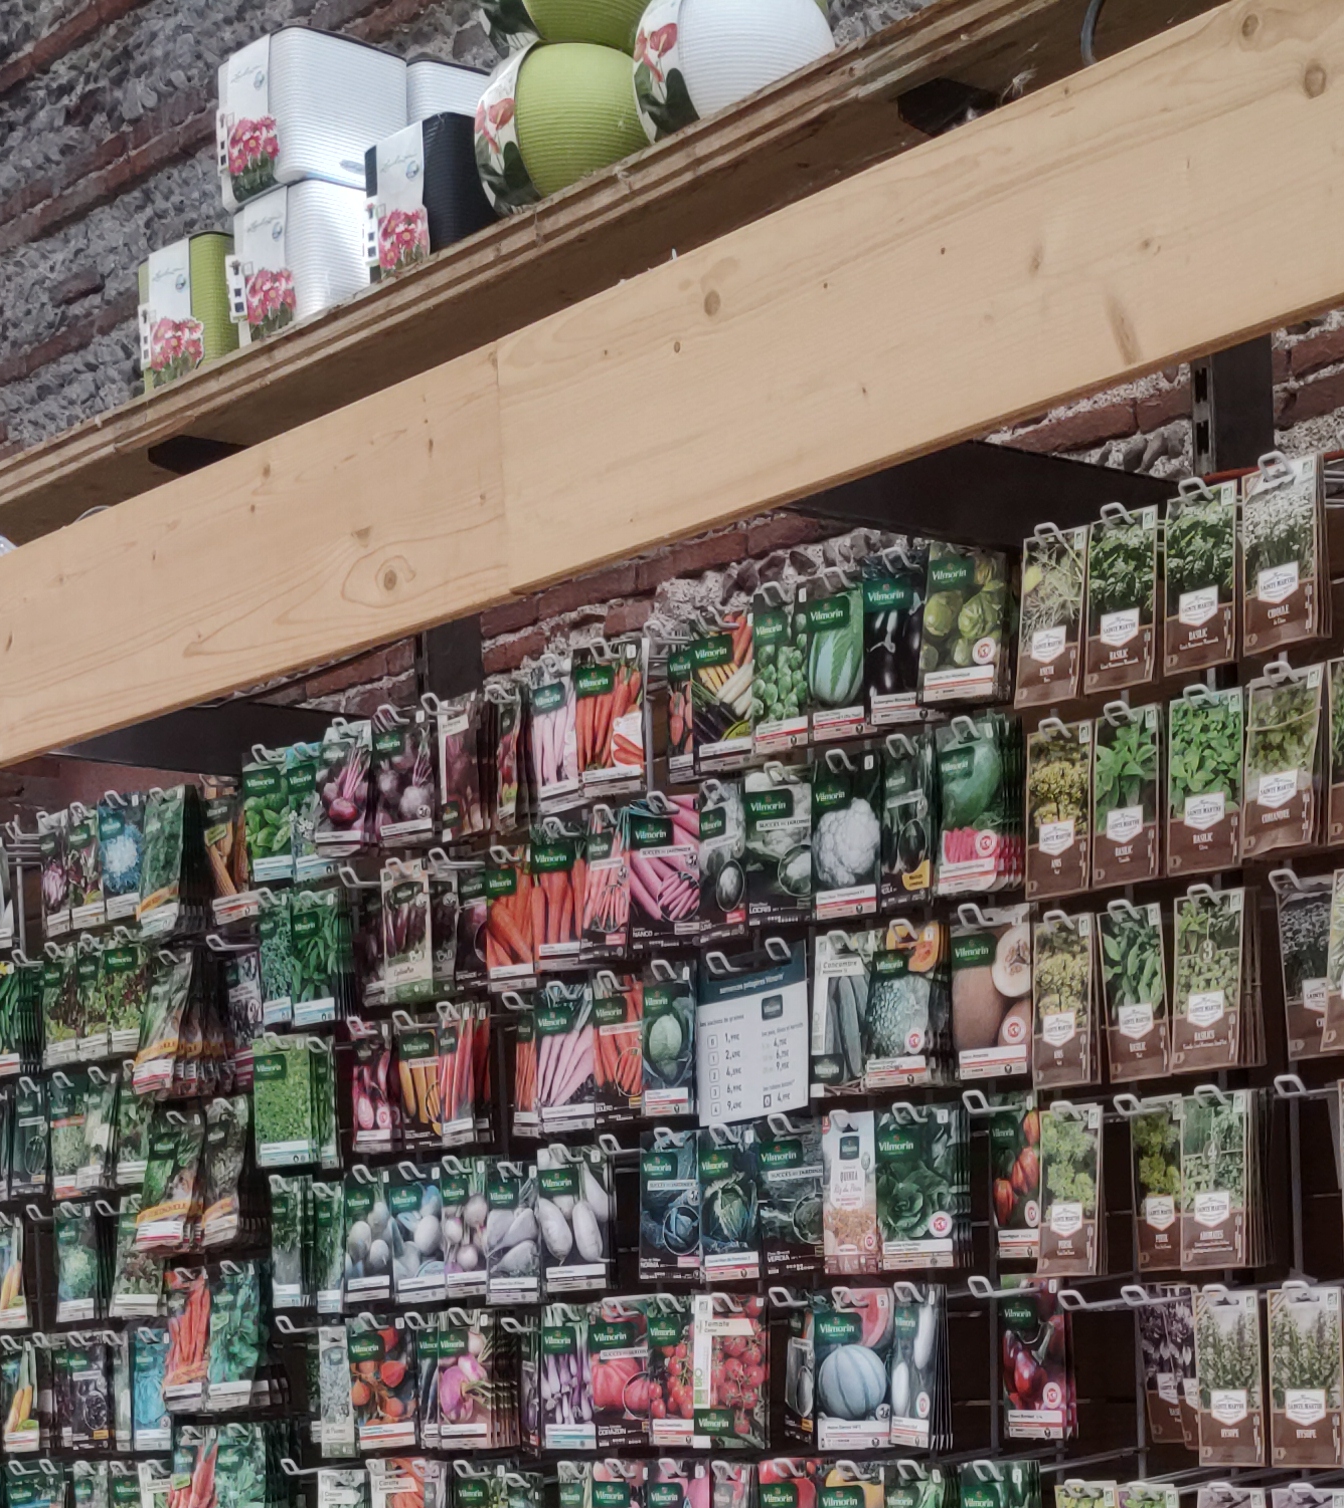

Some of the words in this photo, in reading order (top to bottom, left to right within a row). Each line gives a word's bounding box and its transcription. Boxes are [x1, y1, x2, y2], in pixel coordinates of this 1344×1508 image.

[761, 1151, 797, 1162] Vilmorin
[823, 1496, 858, 1508] Vilmorin
[964, 1497, 994, 1508] Vilmorin
